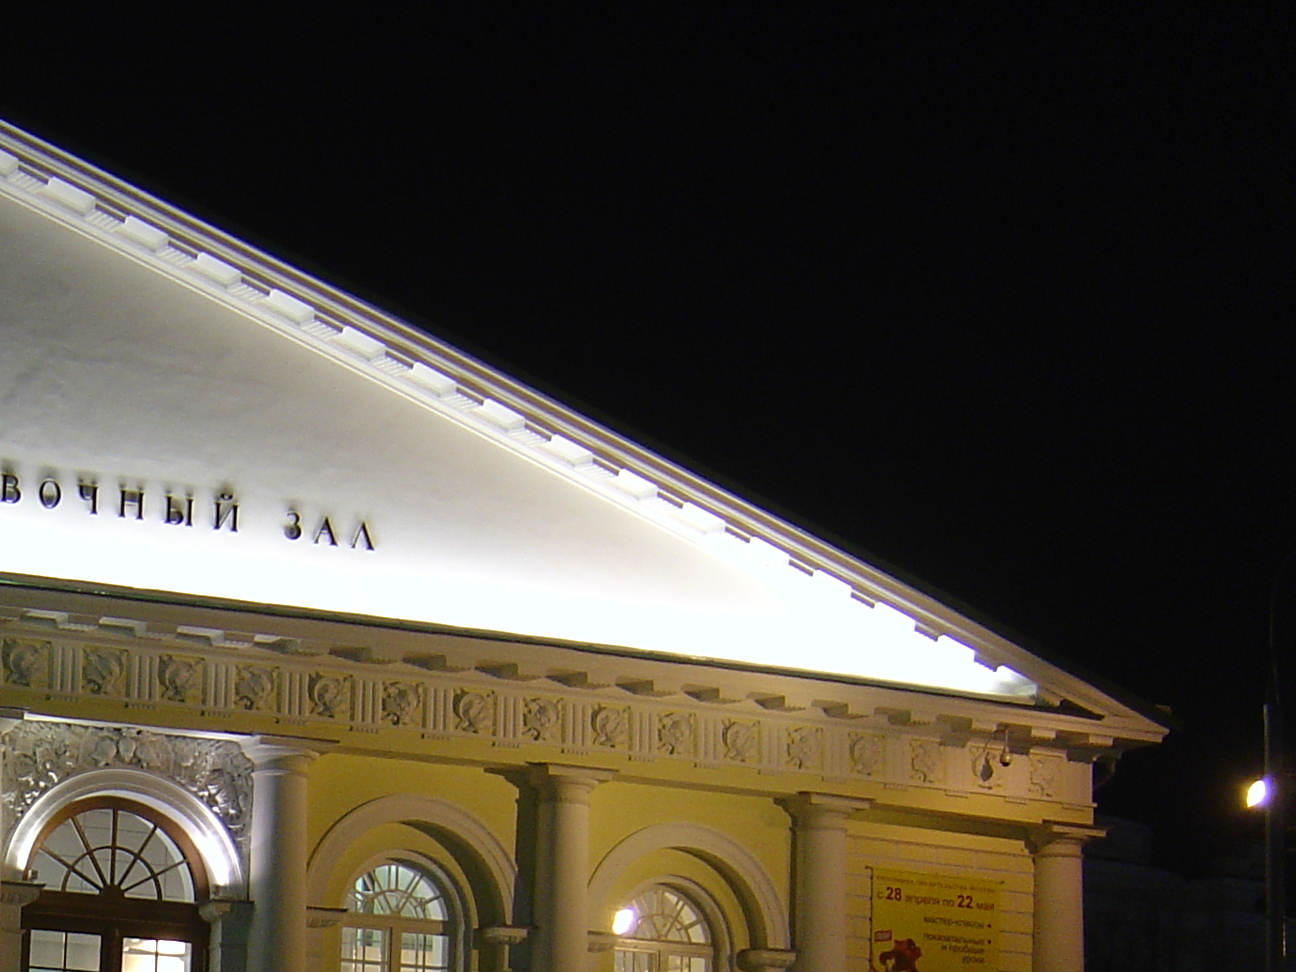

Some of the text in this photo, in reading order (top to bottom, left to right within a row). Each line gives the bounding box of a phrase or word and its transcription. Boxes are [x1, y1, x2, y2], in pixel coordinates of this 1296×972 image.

[282, 509, 376, 551] ЗАЛ
[886, 886, 902, 901] 28
[905, 895, 940, 906] апреля
[942, 899, 955, 907] по
[957, 894, 974, 909] 22
